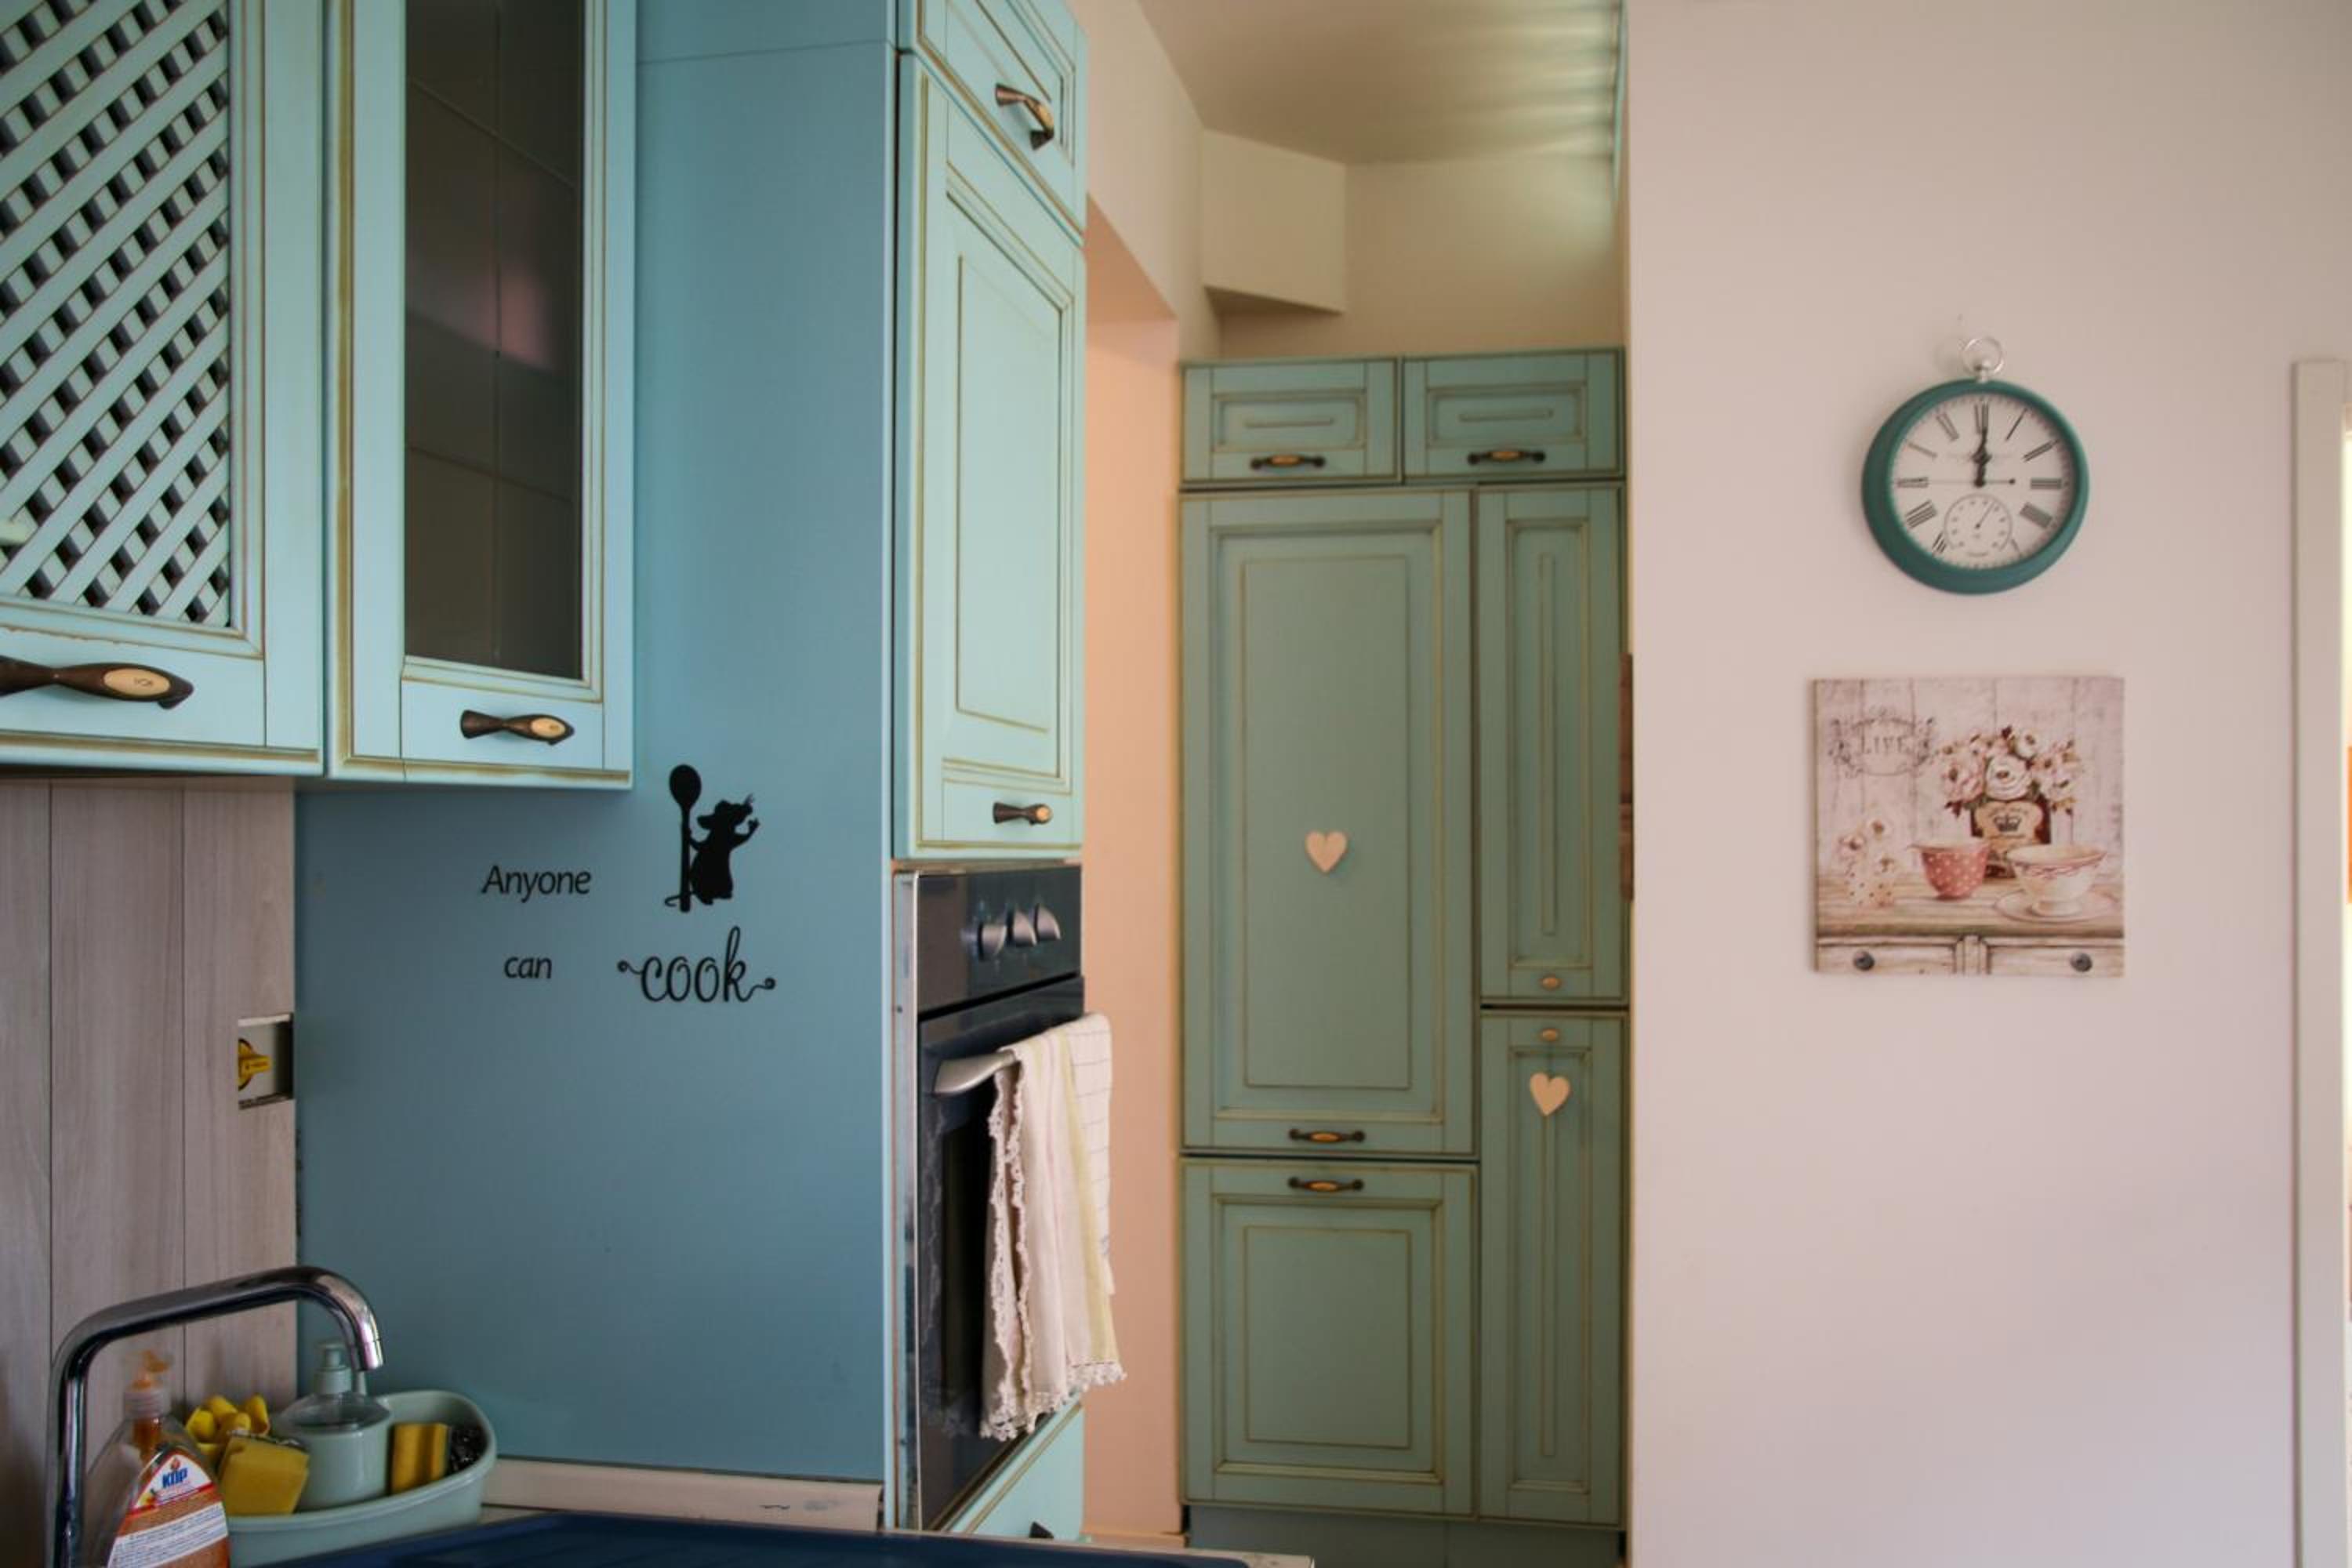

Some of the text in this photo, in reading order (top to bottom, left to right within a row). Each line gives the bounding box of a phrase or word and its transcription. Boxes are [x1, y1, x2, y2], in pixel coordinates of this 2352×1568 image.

[481, 865, 592, 903] Anyone
[503, 925, 776, 1003] can cook
